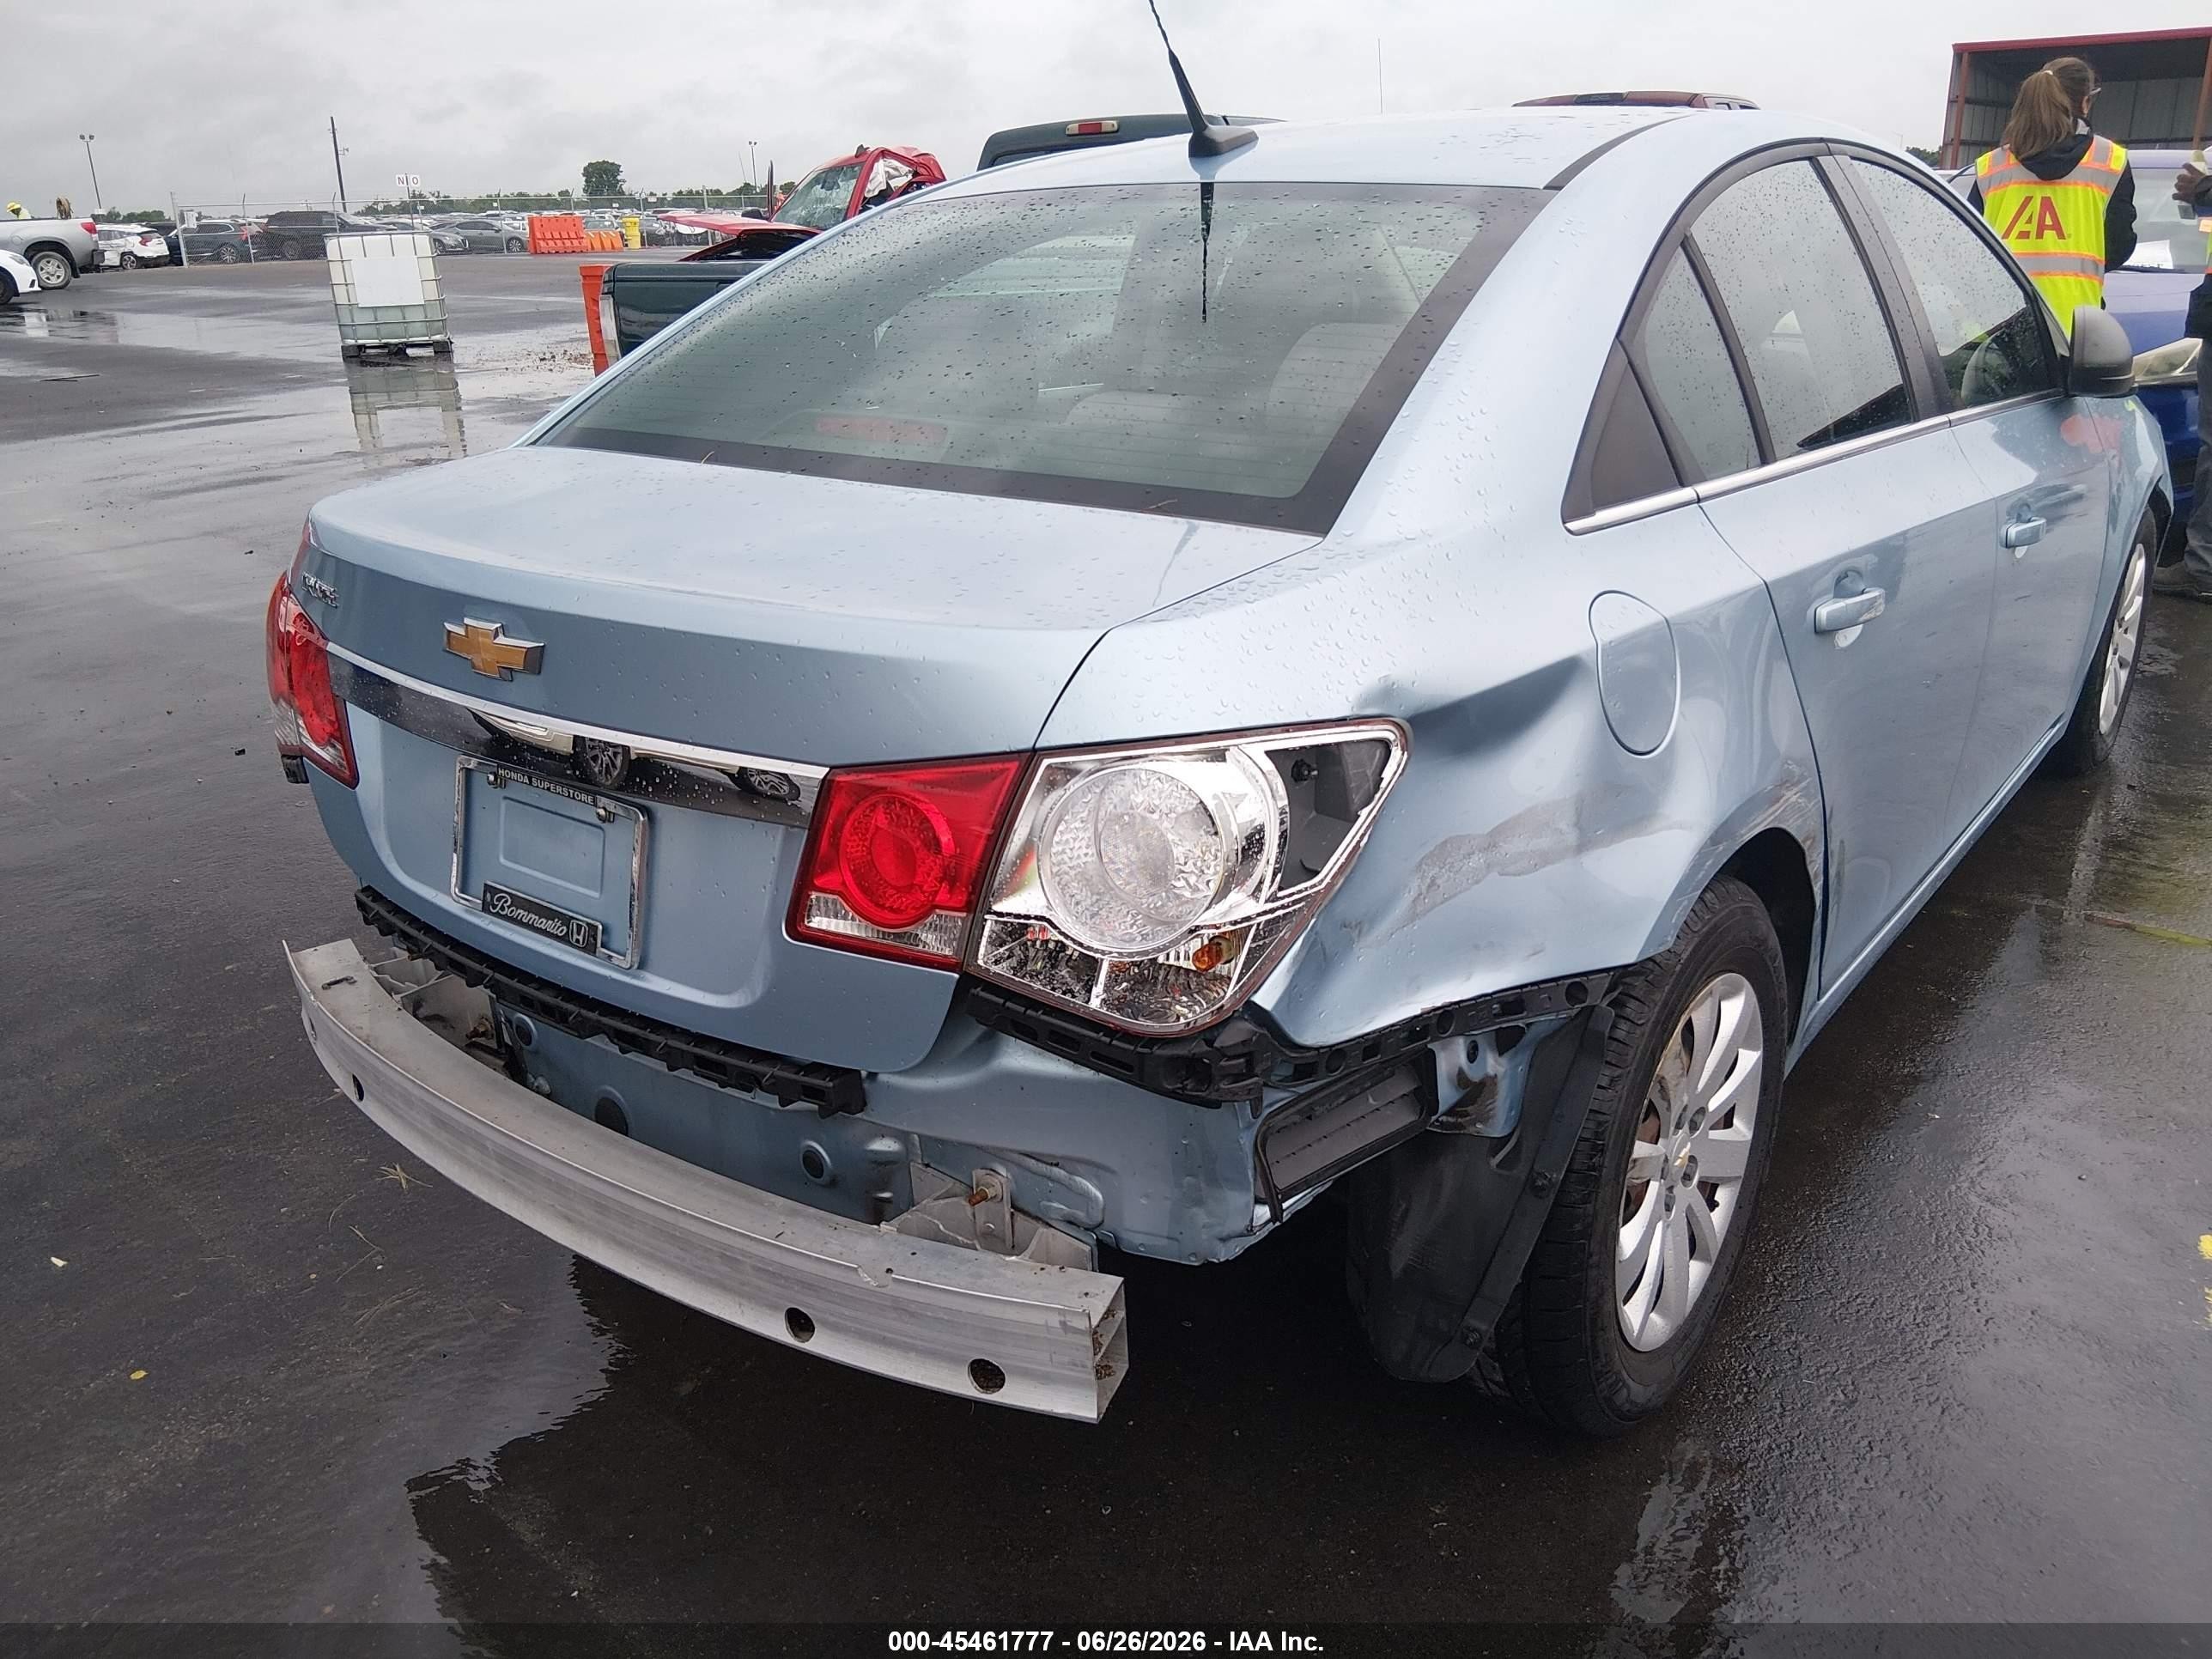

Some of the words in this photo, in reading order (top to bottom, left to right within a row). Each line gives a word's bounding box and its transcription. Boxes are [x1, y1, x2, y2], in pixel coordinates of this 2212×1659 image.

[498, 768, 530, 784] HONDA
[532, 778, 594, 805] SUPERSTORE
[489, 893, 567, 936] Bommarito
